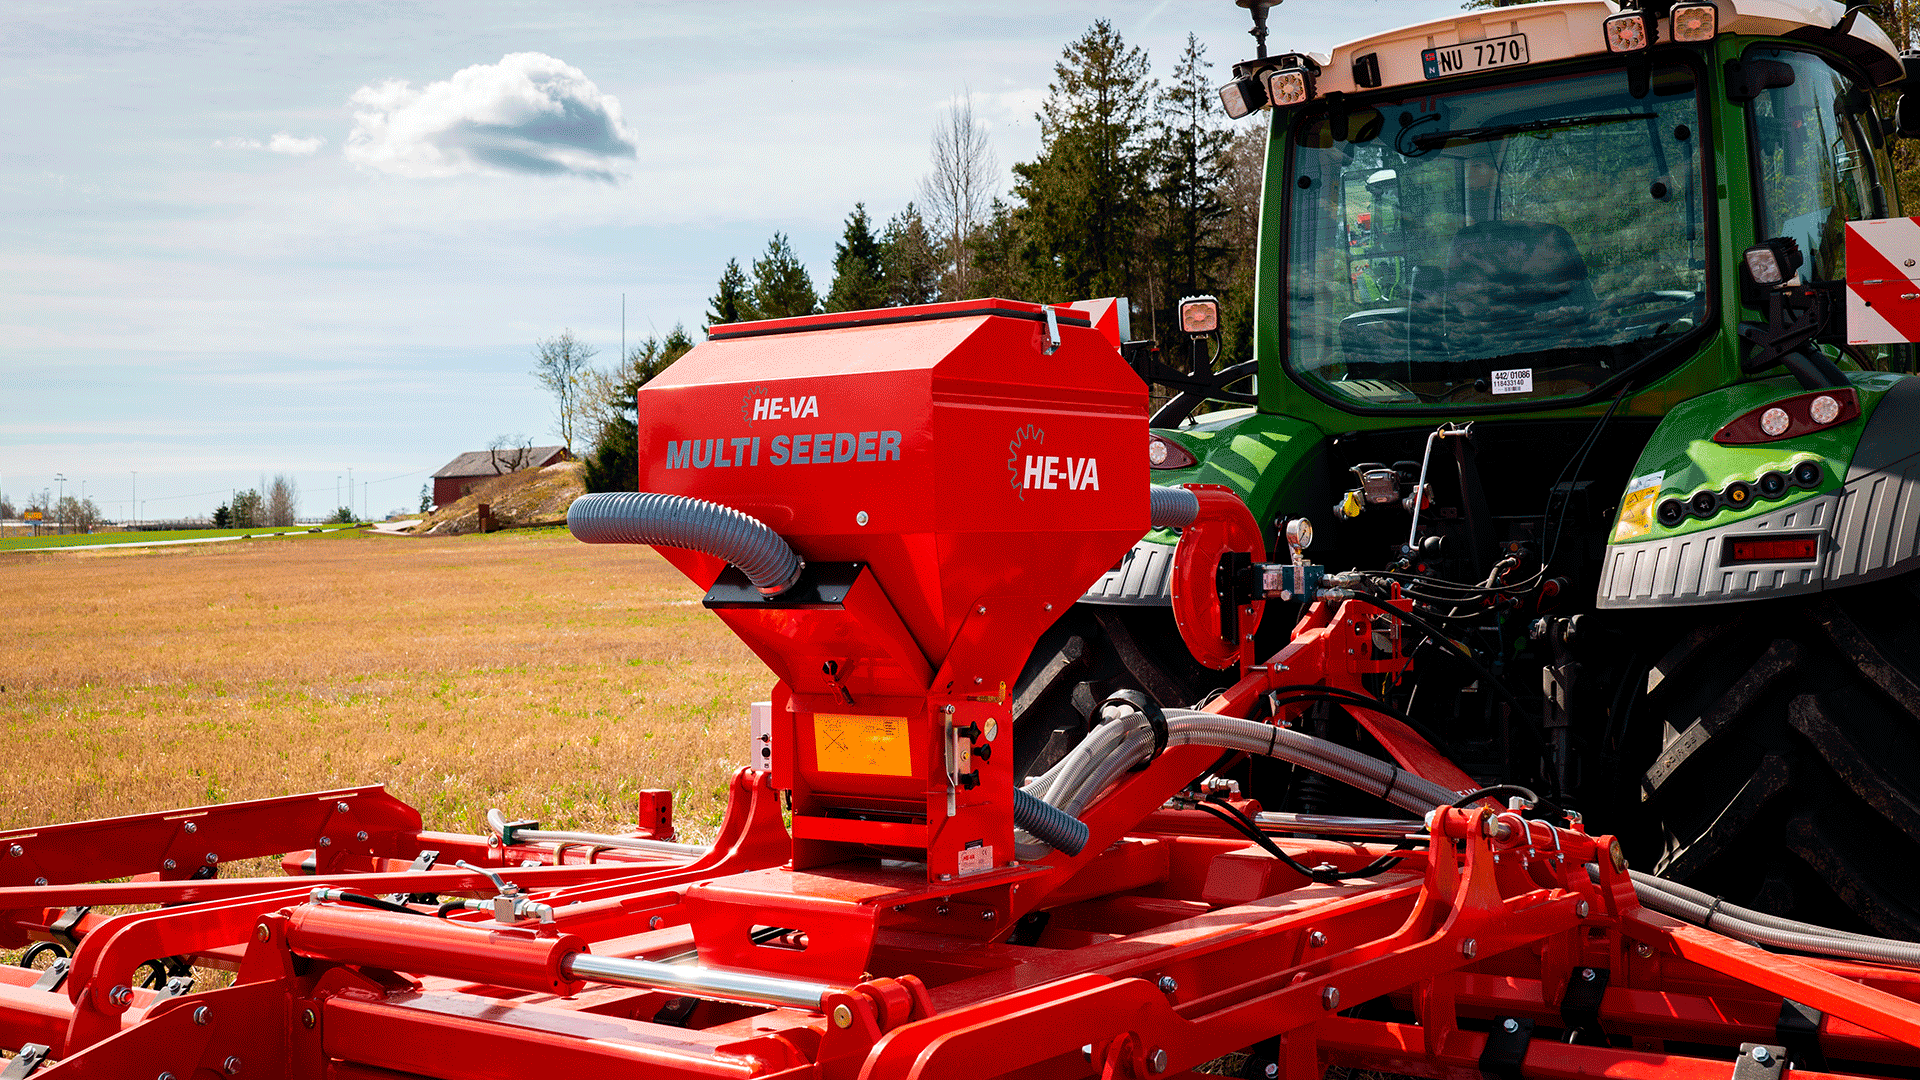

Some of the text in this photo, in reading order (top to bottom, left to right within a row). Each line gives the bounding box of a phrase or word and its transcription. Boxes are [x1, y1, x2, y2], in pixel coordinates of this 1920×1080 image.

[1440, 40, 1520, 72] NU 7270
[753, 395, 819, 420] HE-VA
[666, 430, 902, 469] MULTI SEEDER
[1023, 455, 1100, 491] HE-VA
